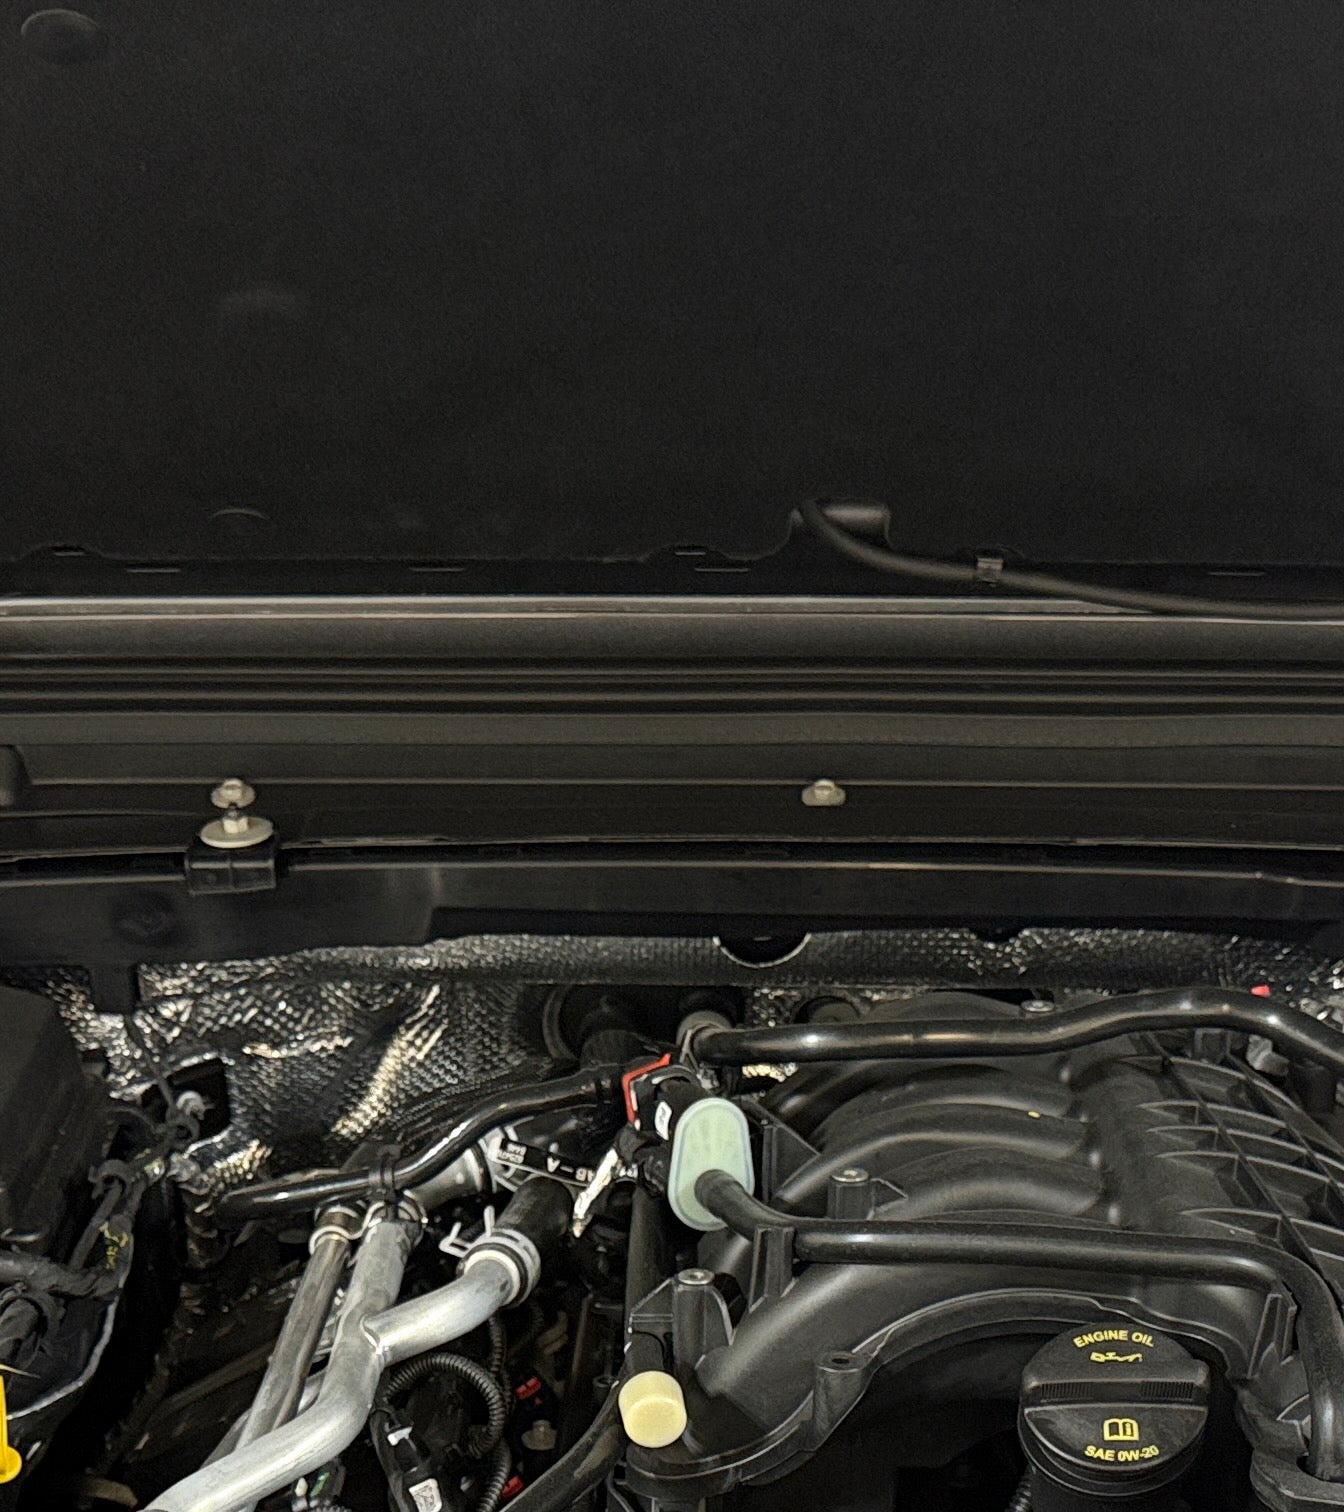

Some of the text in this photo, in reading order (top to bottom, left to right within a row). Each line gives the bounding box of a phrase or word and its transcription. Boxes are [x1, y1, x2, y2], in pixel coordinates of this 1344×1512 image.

[1072, 1330, 1154, 1348] ENGINE OIL
[1084, 1445, 1160, 1461] SAE 0W-20
